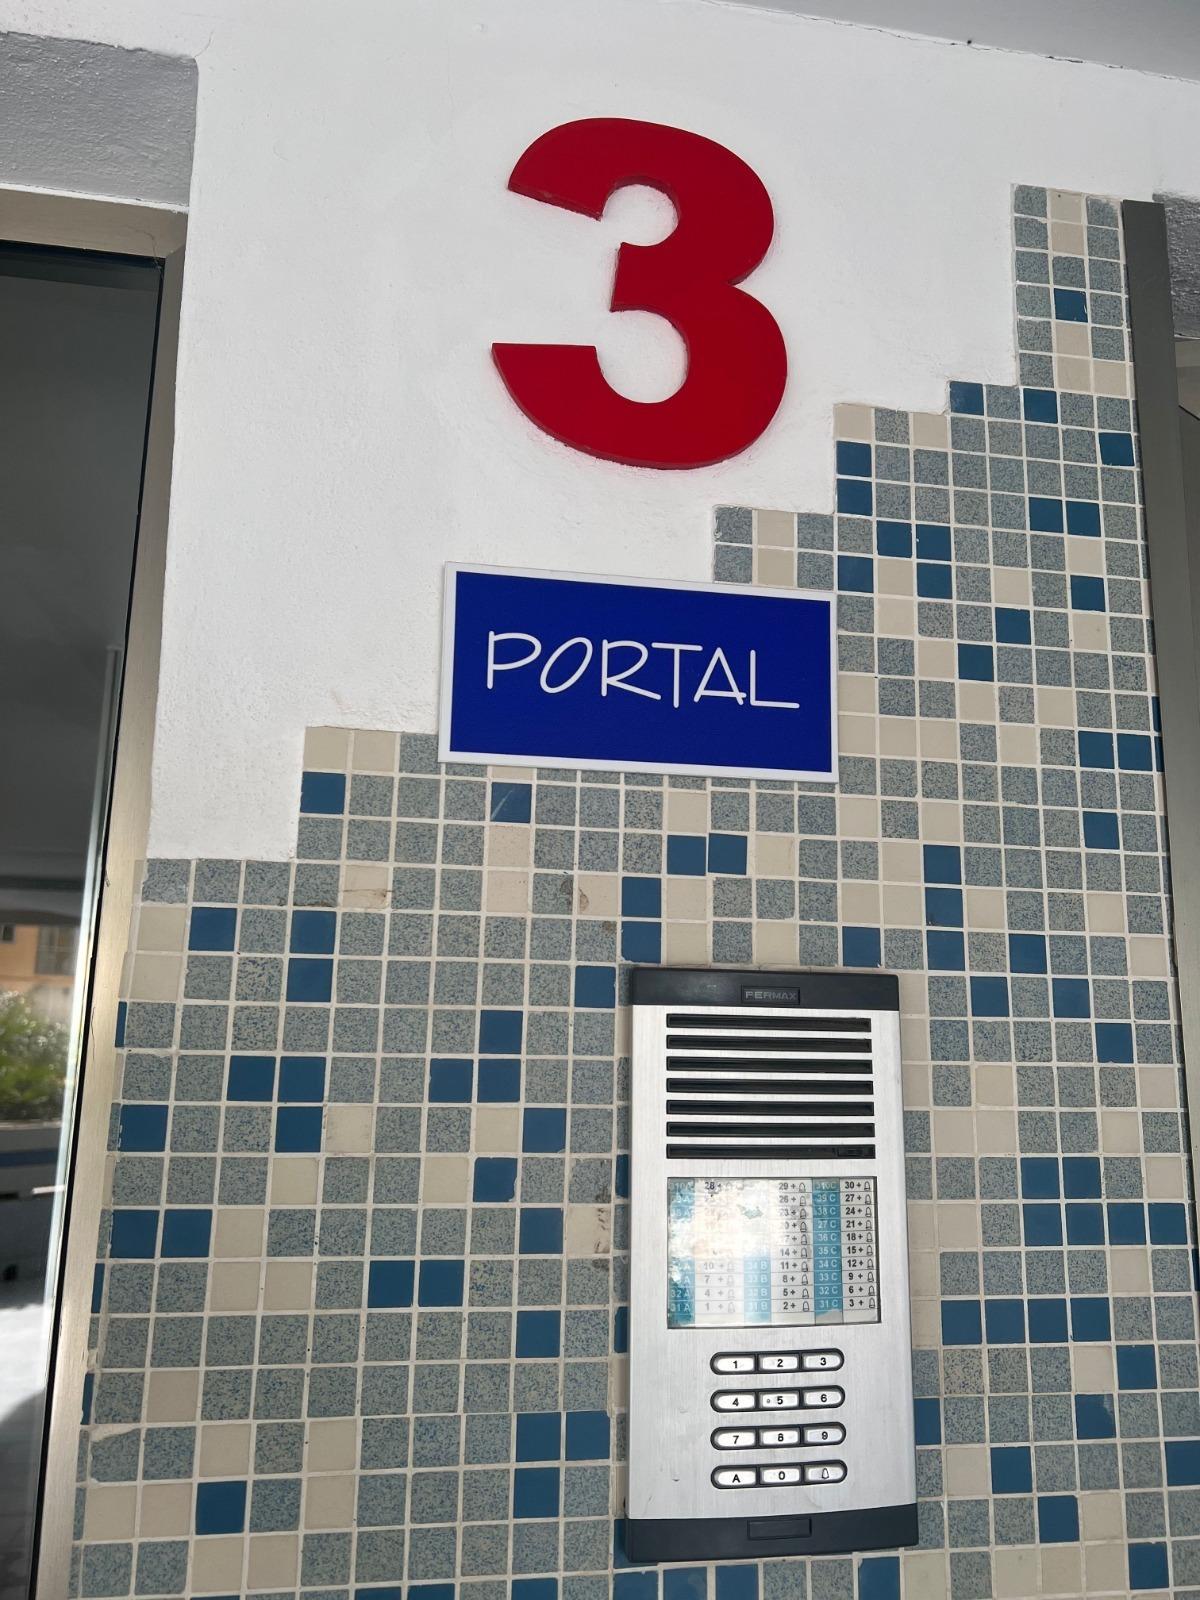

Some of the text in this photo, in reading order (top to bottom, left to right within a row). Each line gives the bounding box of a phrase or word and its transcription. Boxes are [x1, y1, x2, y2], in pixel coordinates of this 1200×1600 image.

[492, 117, 787, 470] 3
[486, 630, 800, 708] PORTAL
[844, 1181, 855, 1189] 30
[845, 1194, 855, 1202] 27
[845, 1207, 856, 1215] 24
[846, 1220, 855, 1228] 21
[846, 1233, 856, 1241] 18
[780, 1247, 790, 1256] 14
[818, 1247, 829, 1255] 35
[847, 1246, 857, 1254] 15
[703, 1261, 715, 1270] 10
[780, 1261, 789, 1269] 11
[818, 1260, 829, 1268] 34
[847, 1259, 857, 1268] 12
[819, 1273, 829, 1281] 33
[848, 1273, 854, 1281] 9
[703, 1288, 711, 1297] 4
[783, 1288, 788, 1296] 5
[819, 1287, 830, 1295] 32
[848, 1286, 854, 1294] 6
[783, 1302, 789, 1310] 2
[819, 1300, 829, 1308] 31
[849, 1299, 855, 1307] 3
[732, 1357, 827, 1369] 1 2 3
[732, 1394, 828, 1407] 4 5 6
[732, 1431, 828, 1444] 7 8 9
[732, 1471, 785, 1483] A 0
